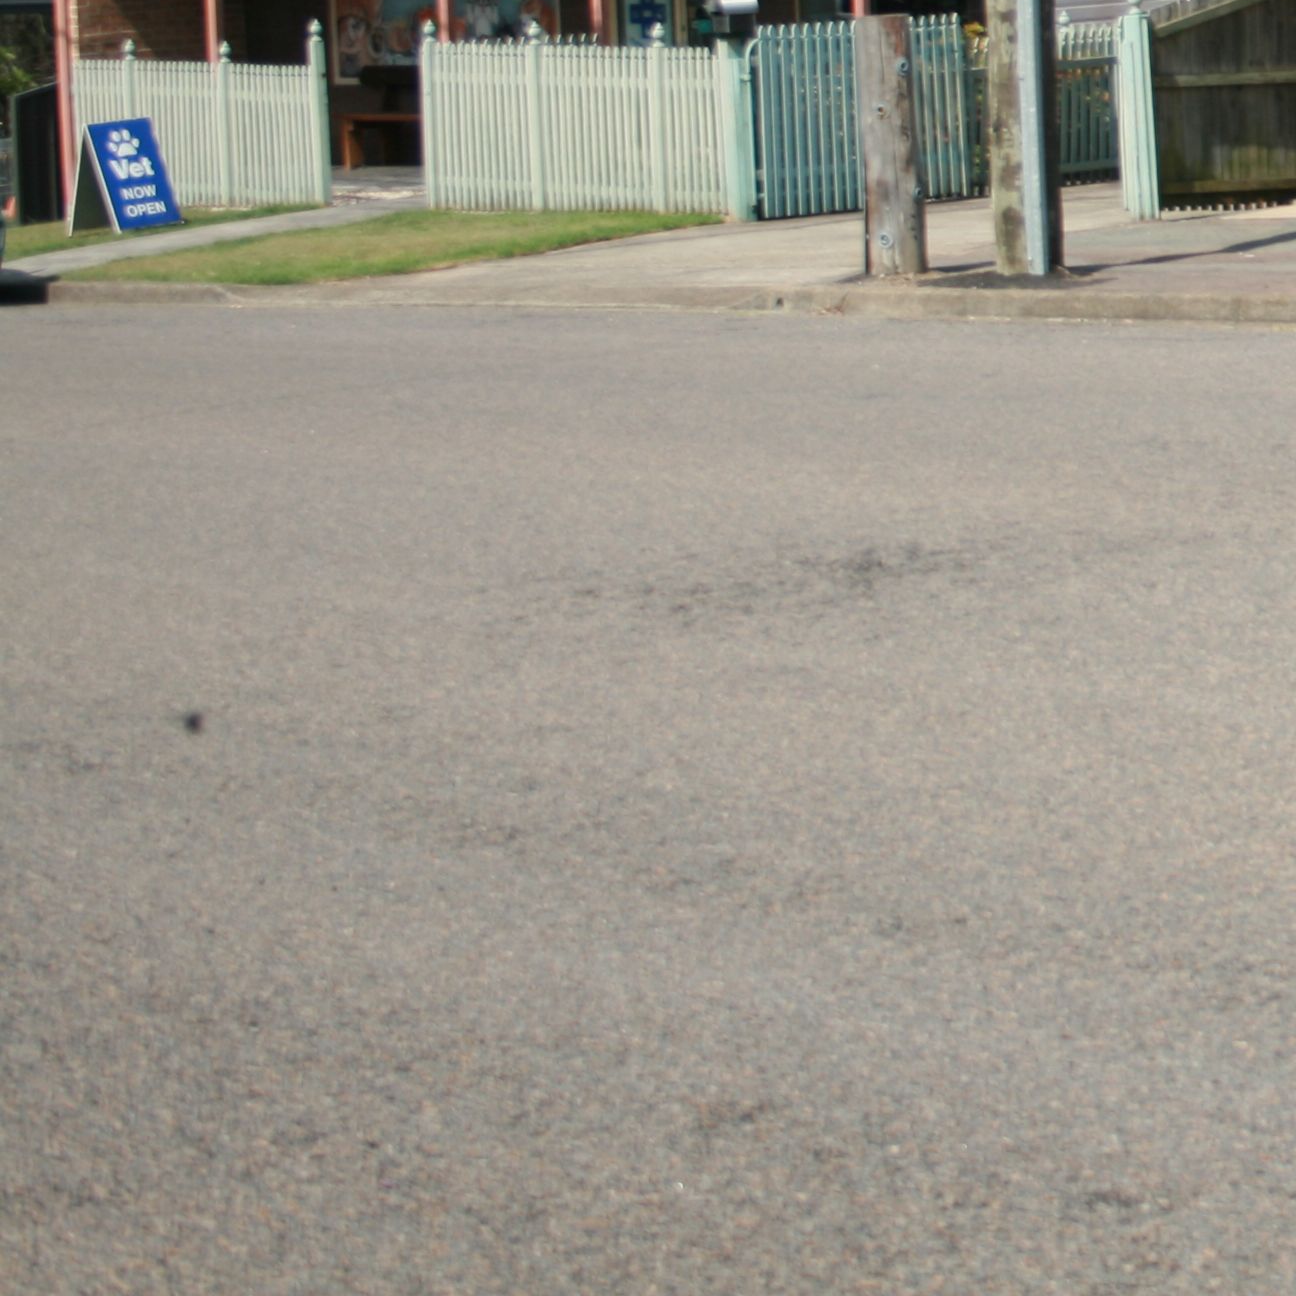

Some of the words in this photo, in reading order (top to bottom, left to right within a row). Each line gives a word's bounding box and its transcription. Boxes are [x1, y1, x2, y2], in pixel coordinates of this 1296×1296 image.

[108, 156, 155, 180] Vet
[120, 184, 157, 201] NOW
[125, 200, 167, 218] OPEN
